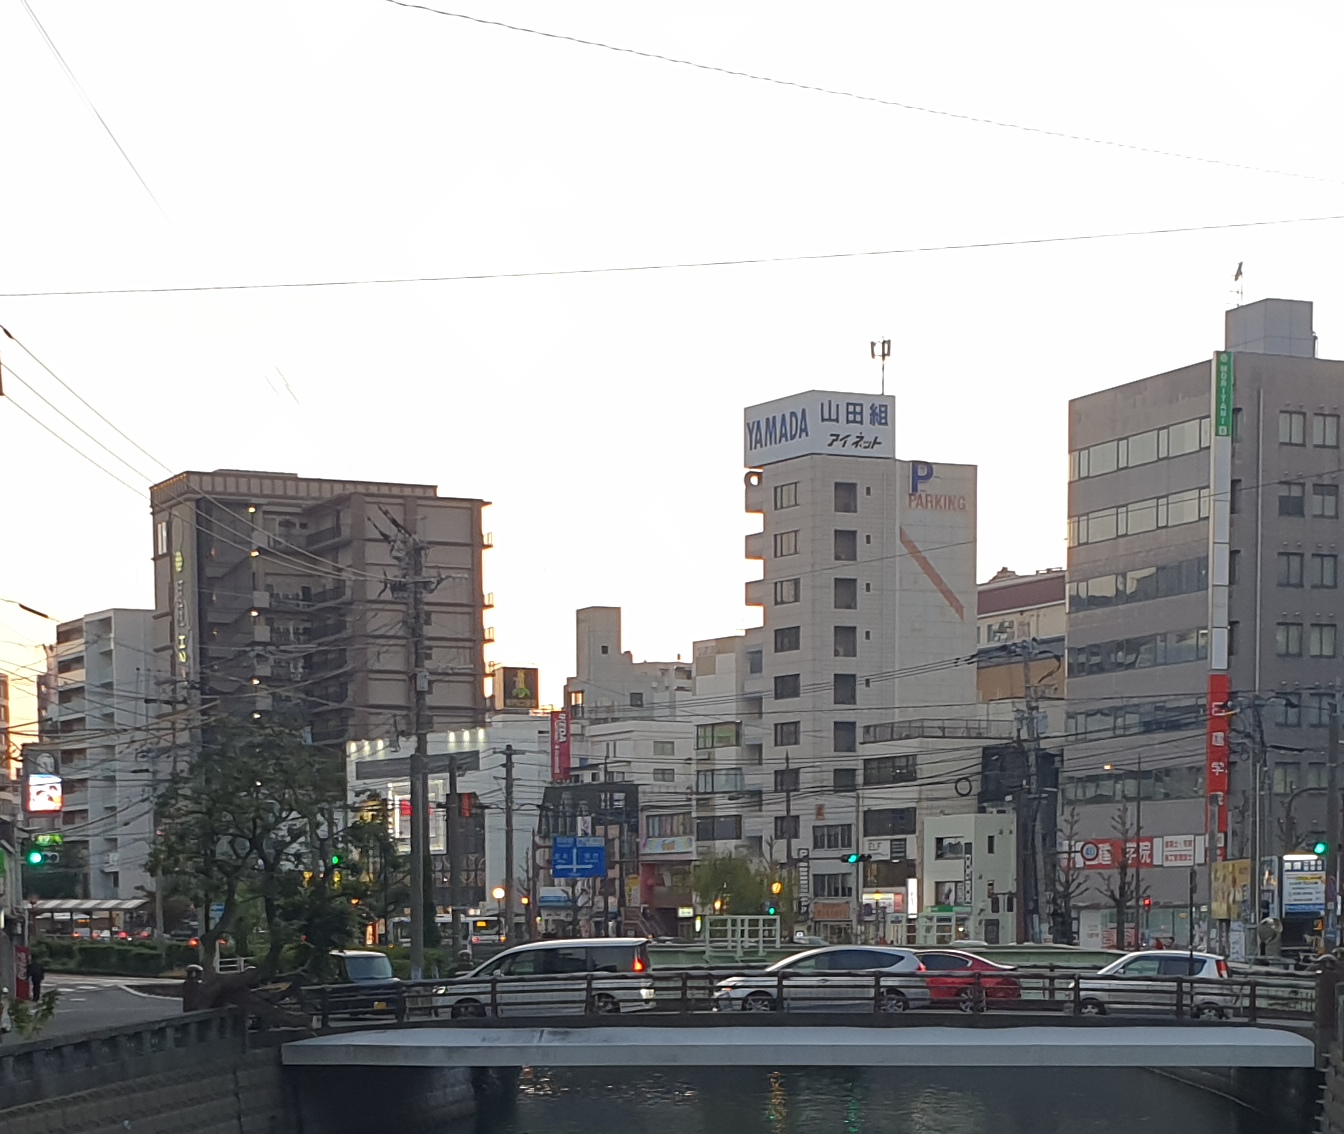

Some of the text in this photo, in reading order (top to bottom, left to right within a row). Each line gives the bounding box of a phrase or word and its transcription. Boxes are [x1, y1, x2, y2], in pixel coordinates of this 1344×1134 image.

[820, 399, 889, 426] 山田組
[746, 408, 810, 451] YAMADA
[827, 431, 883, 449] アイネット
[911, 461, 934, 494] P
[908, 493, 966, 511] PARKING
